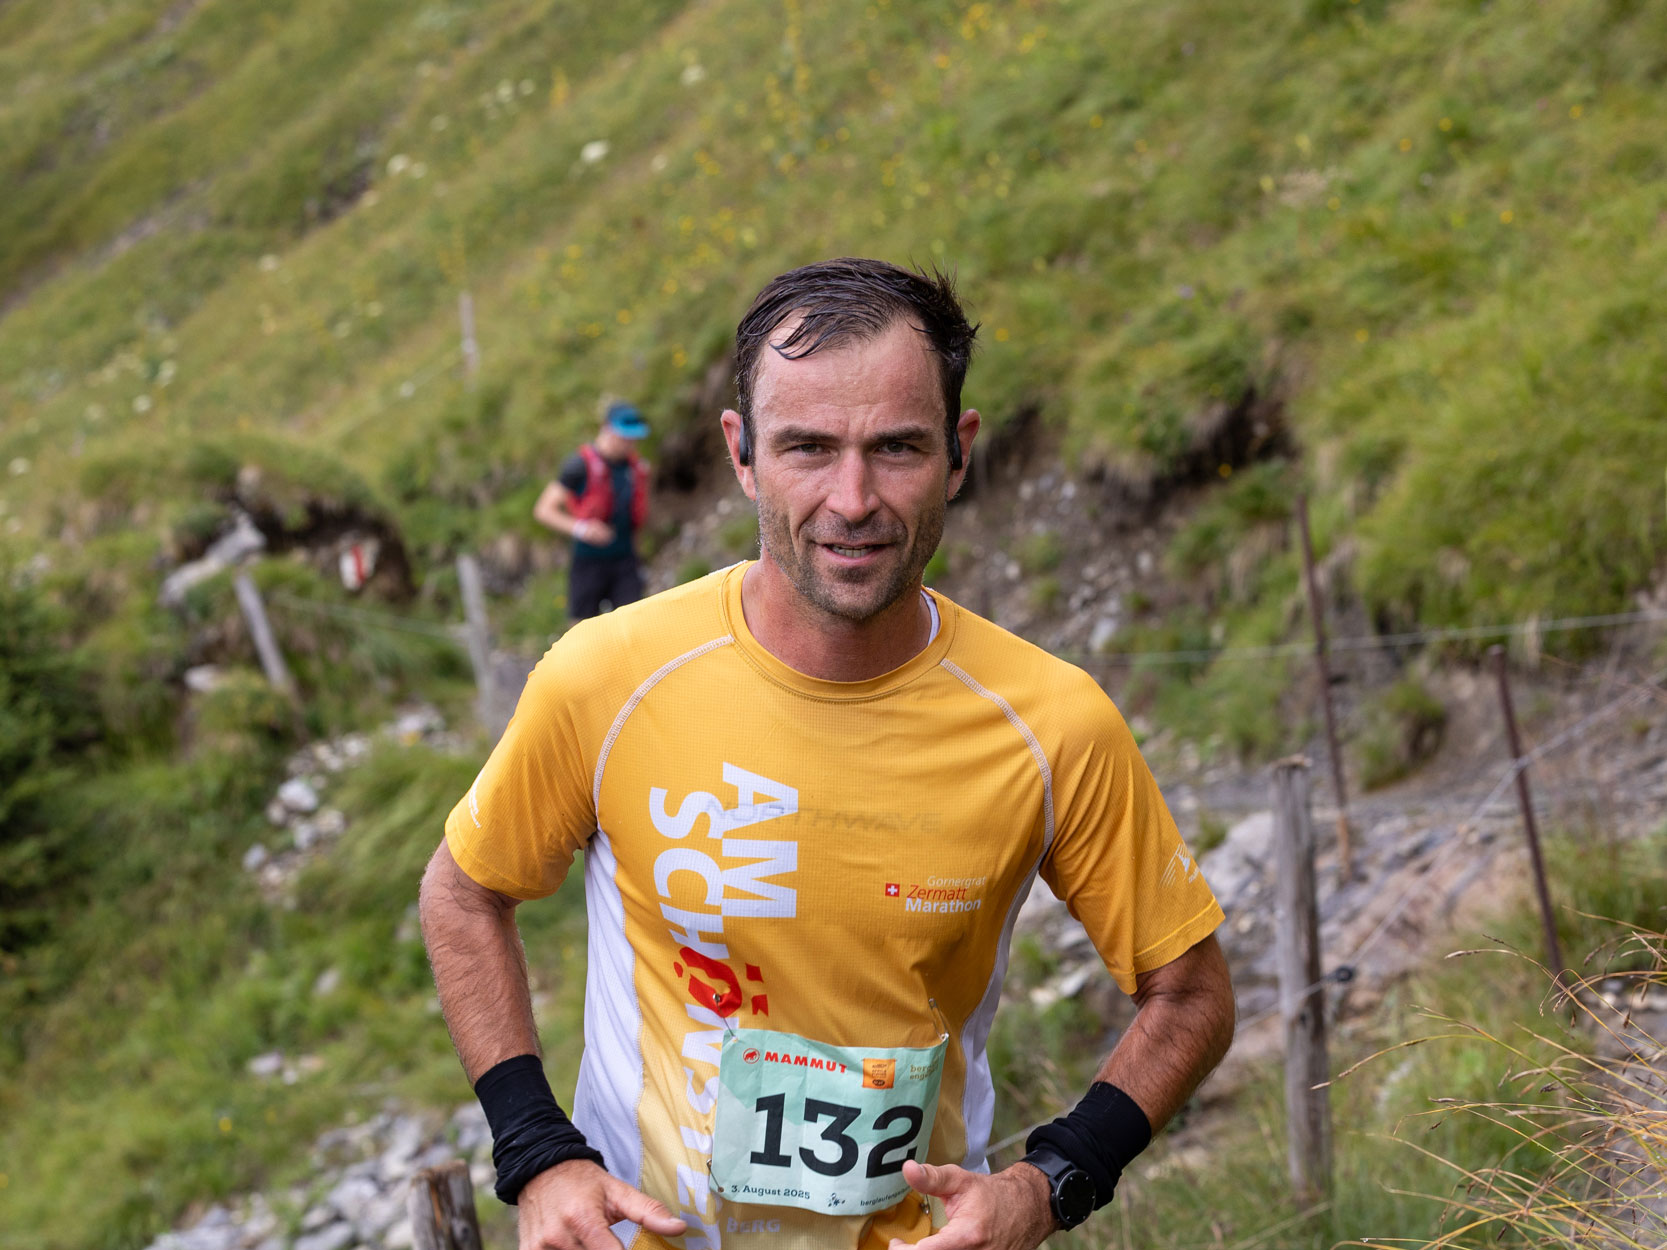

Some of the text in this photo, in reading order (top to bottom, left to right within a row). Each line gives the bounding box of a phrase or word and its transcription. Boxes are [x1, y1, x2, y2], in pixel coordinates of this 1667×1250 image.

[722, 762, 799, 919] AM
[927, 875, 987, 889] Gornergrat
[906, 885, 968, 901] Zermatt
[904, 897, 982, 913] Marathon
[764, 1051, 848, 1074] MAMMUT
[750, 1092, 924, 1179] 132
[731, 1184, 811, 1200] 3. August 2025
[726, 1216, 781, 1233] BERG
